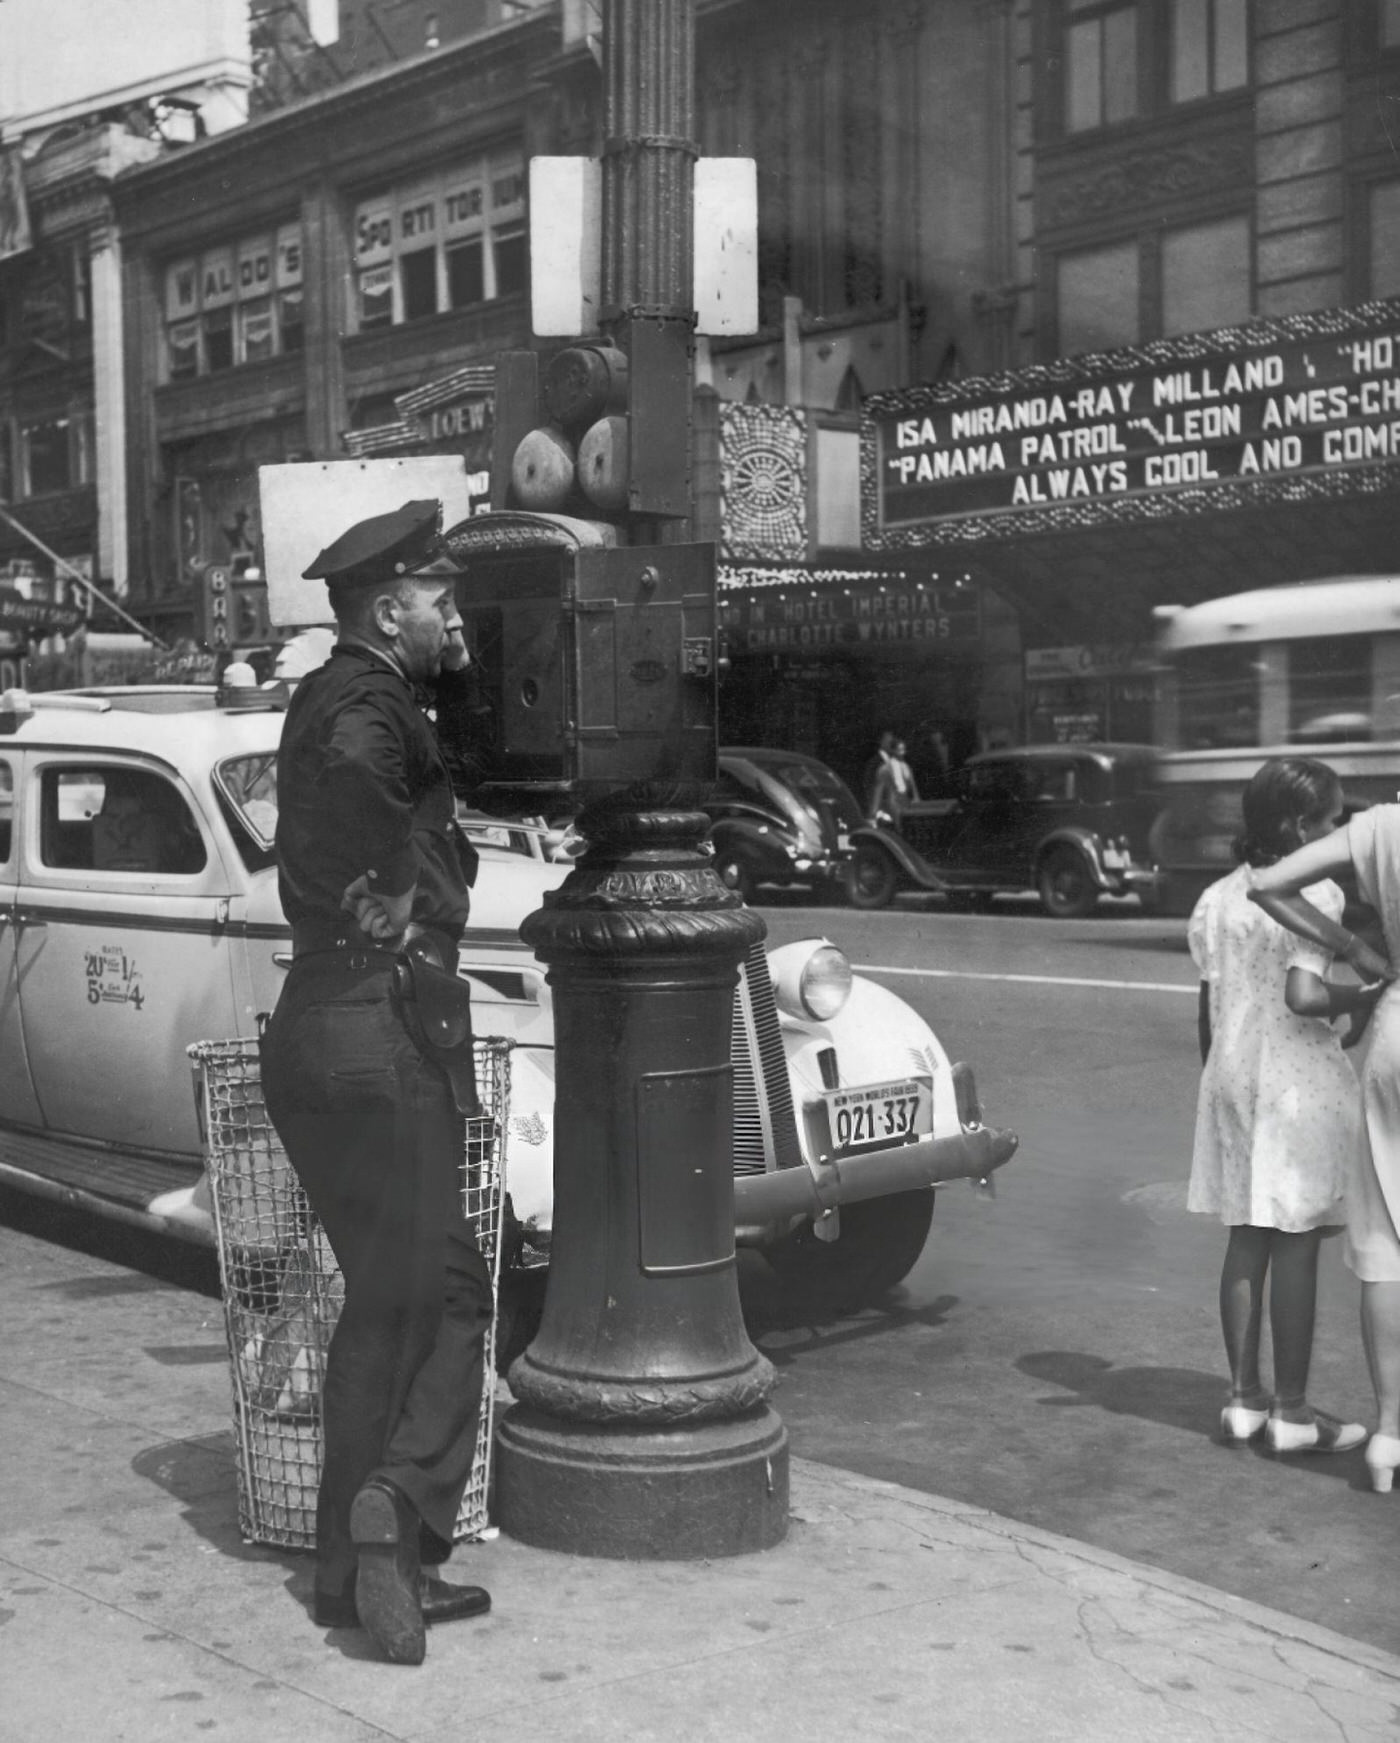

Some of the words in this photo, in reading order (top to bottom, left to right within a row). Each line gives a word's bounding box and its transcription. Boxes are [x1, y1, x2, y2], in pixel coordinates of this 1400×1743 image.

[897, 417, 937, 449] ISA
[952, 382, 1134, 440] MIRANDA-RAY
[1153, 355, 1283, 407] MILLAND
[1165, 403, 1241, 444] LEON
[1012, 461, 1127, 505] ALWAYS
[1145, 449, 1219, 486] COOL
[1239, 435, 1302, 475] AND
[857, 617, 950, 641] WYNTERS
